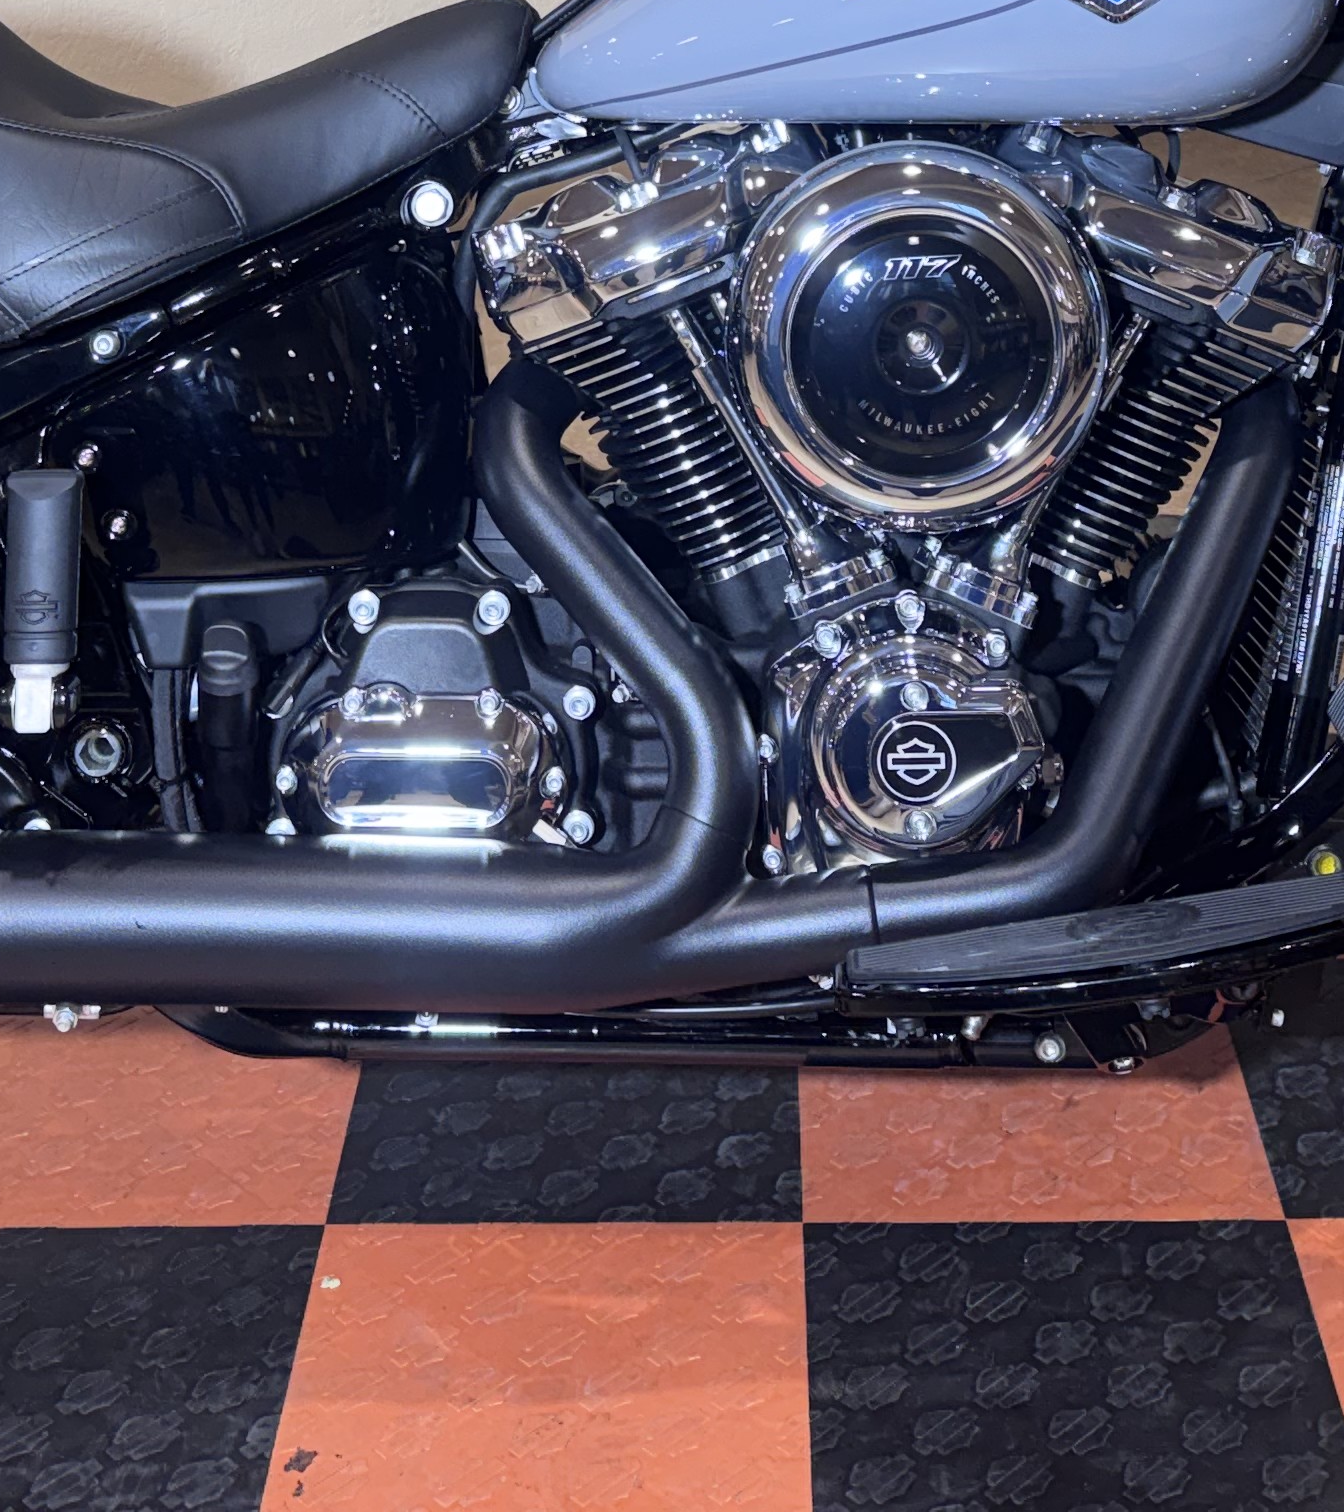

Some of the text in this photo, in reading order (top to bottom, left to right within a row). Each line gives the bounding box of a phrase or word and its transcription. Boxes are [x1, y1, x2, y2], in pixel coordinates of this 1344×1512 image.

[839, 254, 1000, 314] CUBIC 117 INCHES
[858, 392, 995, 435] MILWAUKEE-EIGHT
